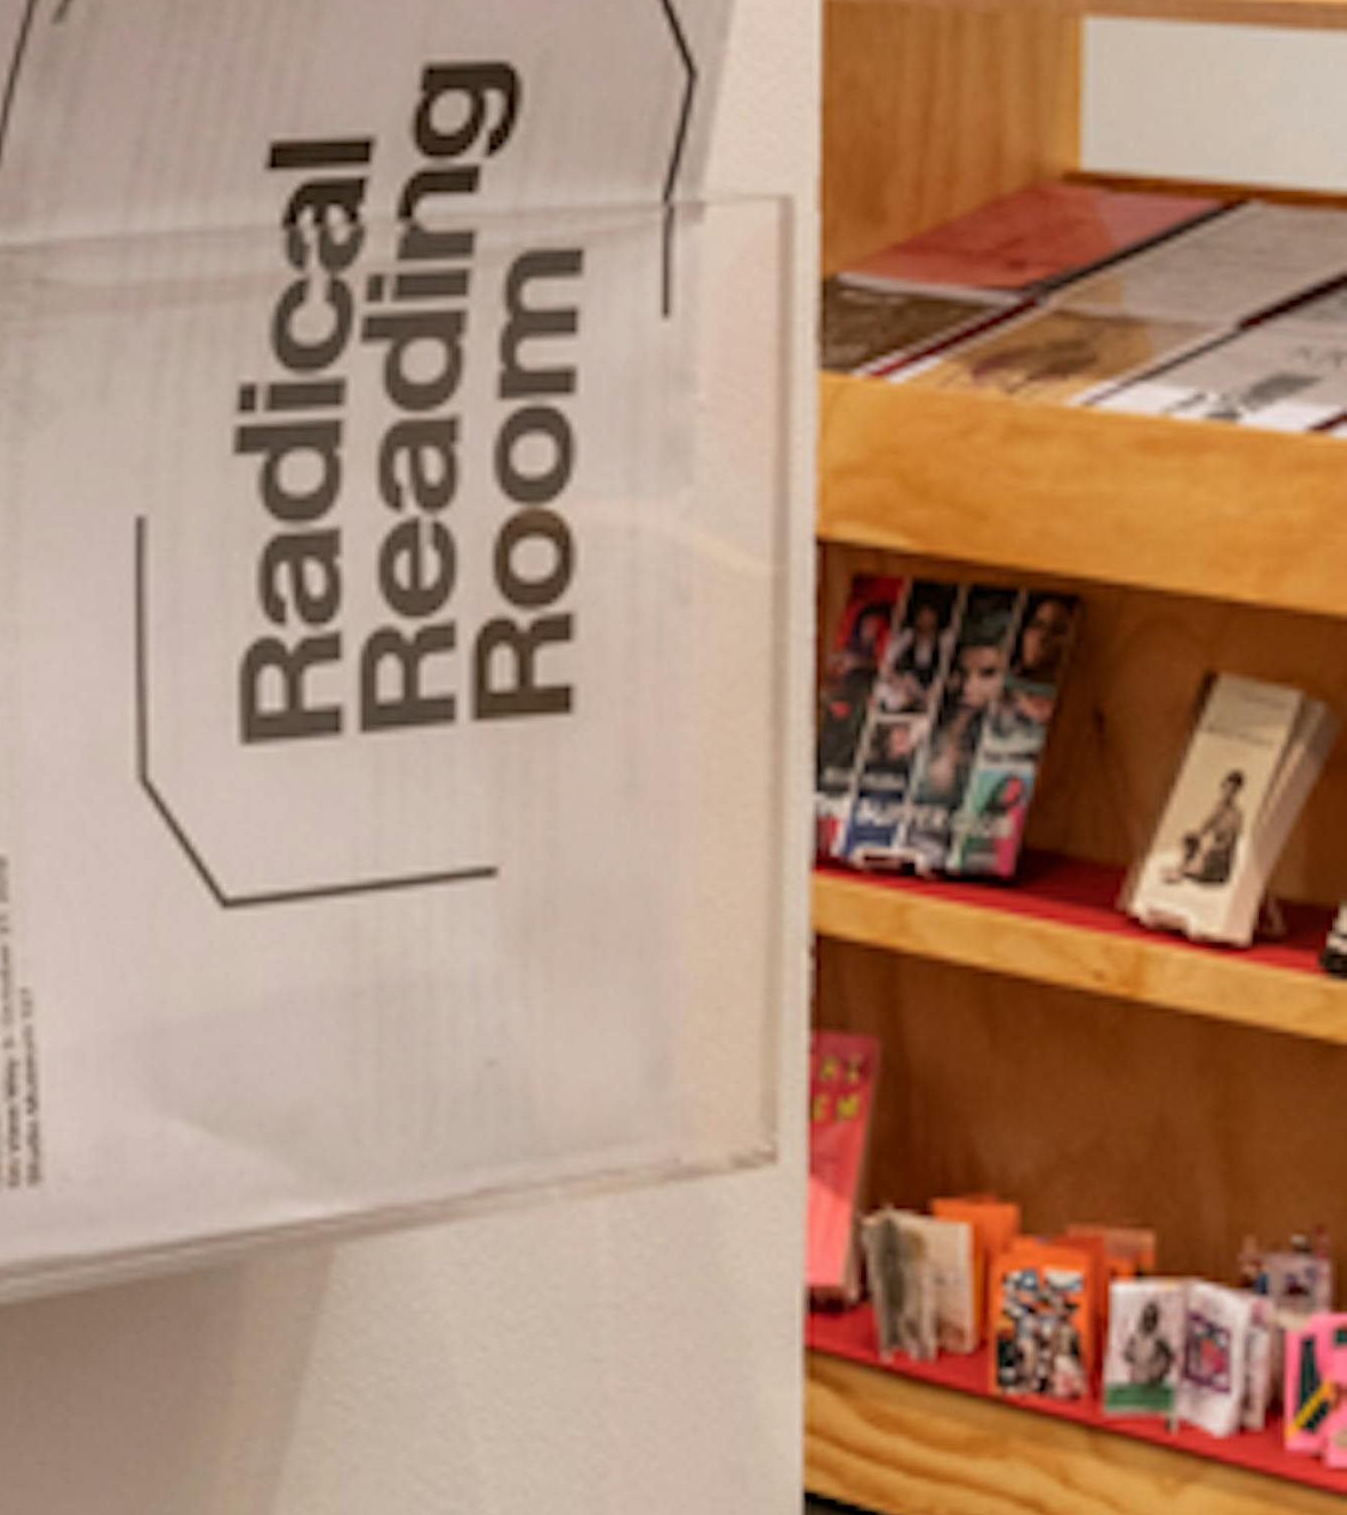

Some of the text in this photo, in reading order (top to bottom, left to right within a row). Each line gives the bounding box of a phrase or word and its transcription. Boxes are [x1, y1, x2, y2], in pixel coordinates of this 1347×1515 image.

[233, 135, 374, 745] Radical
[359, 61, 522, 734] Reading
[471, 247, 584, 722] Room
